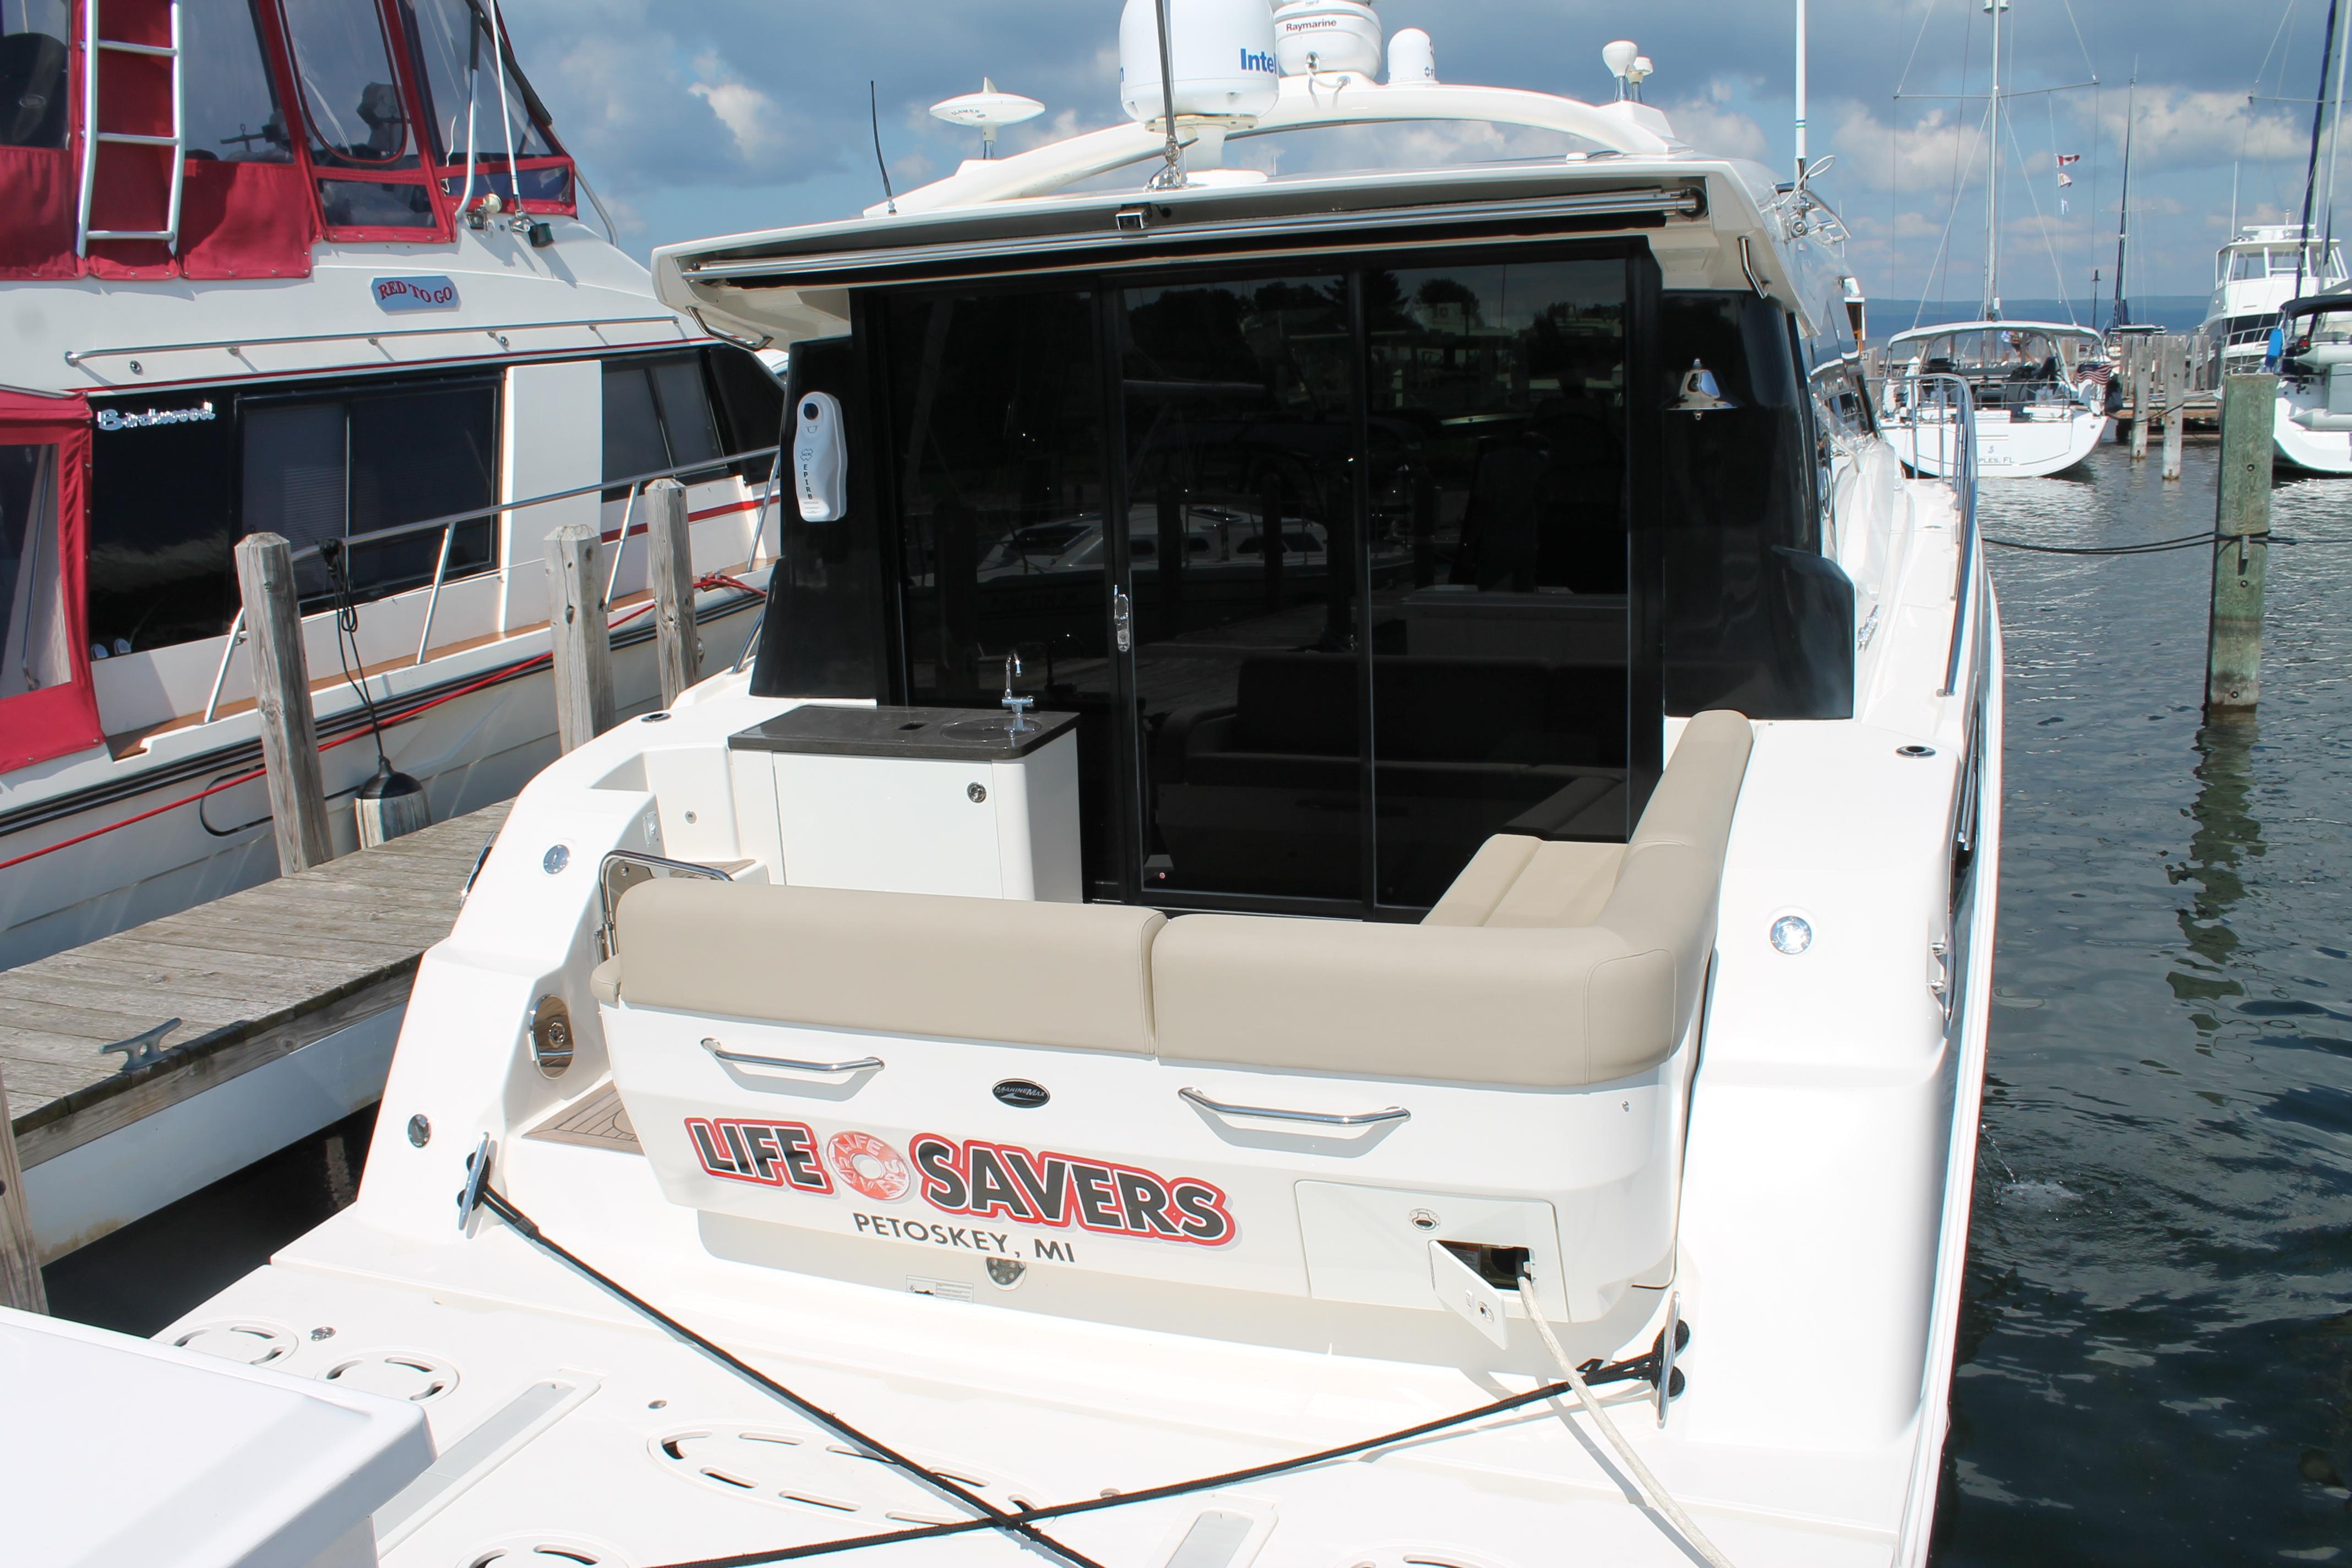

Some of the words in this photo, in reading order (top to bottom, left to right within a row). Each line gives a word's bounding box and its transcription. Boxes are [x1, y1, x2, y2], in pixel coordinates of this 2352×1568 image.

[1285, 19, 1337, 32] Raymarine
[378, 280, 407, 300] RED
[408, 282, 432, 303] TO
[433, 286, 453, 304] GO
[803, 464, 814, 500] EPIRB
[833, 1134, 884, 1156] LIFE
[688, 1121, 829, 1190] LIFE
[913, 1137, 1229, 1241] SAVERS
[852, 1212, 1021, 1258] PETOSKEY,
[1033, 1238, 1076, 1263] MI
